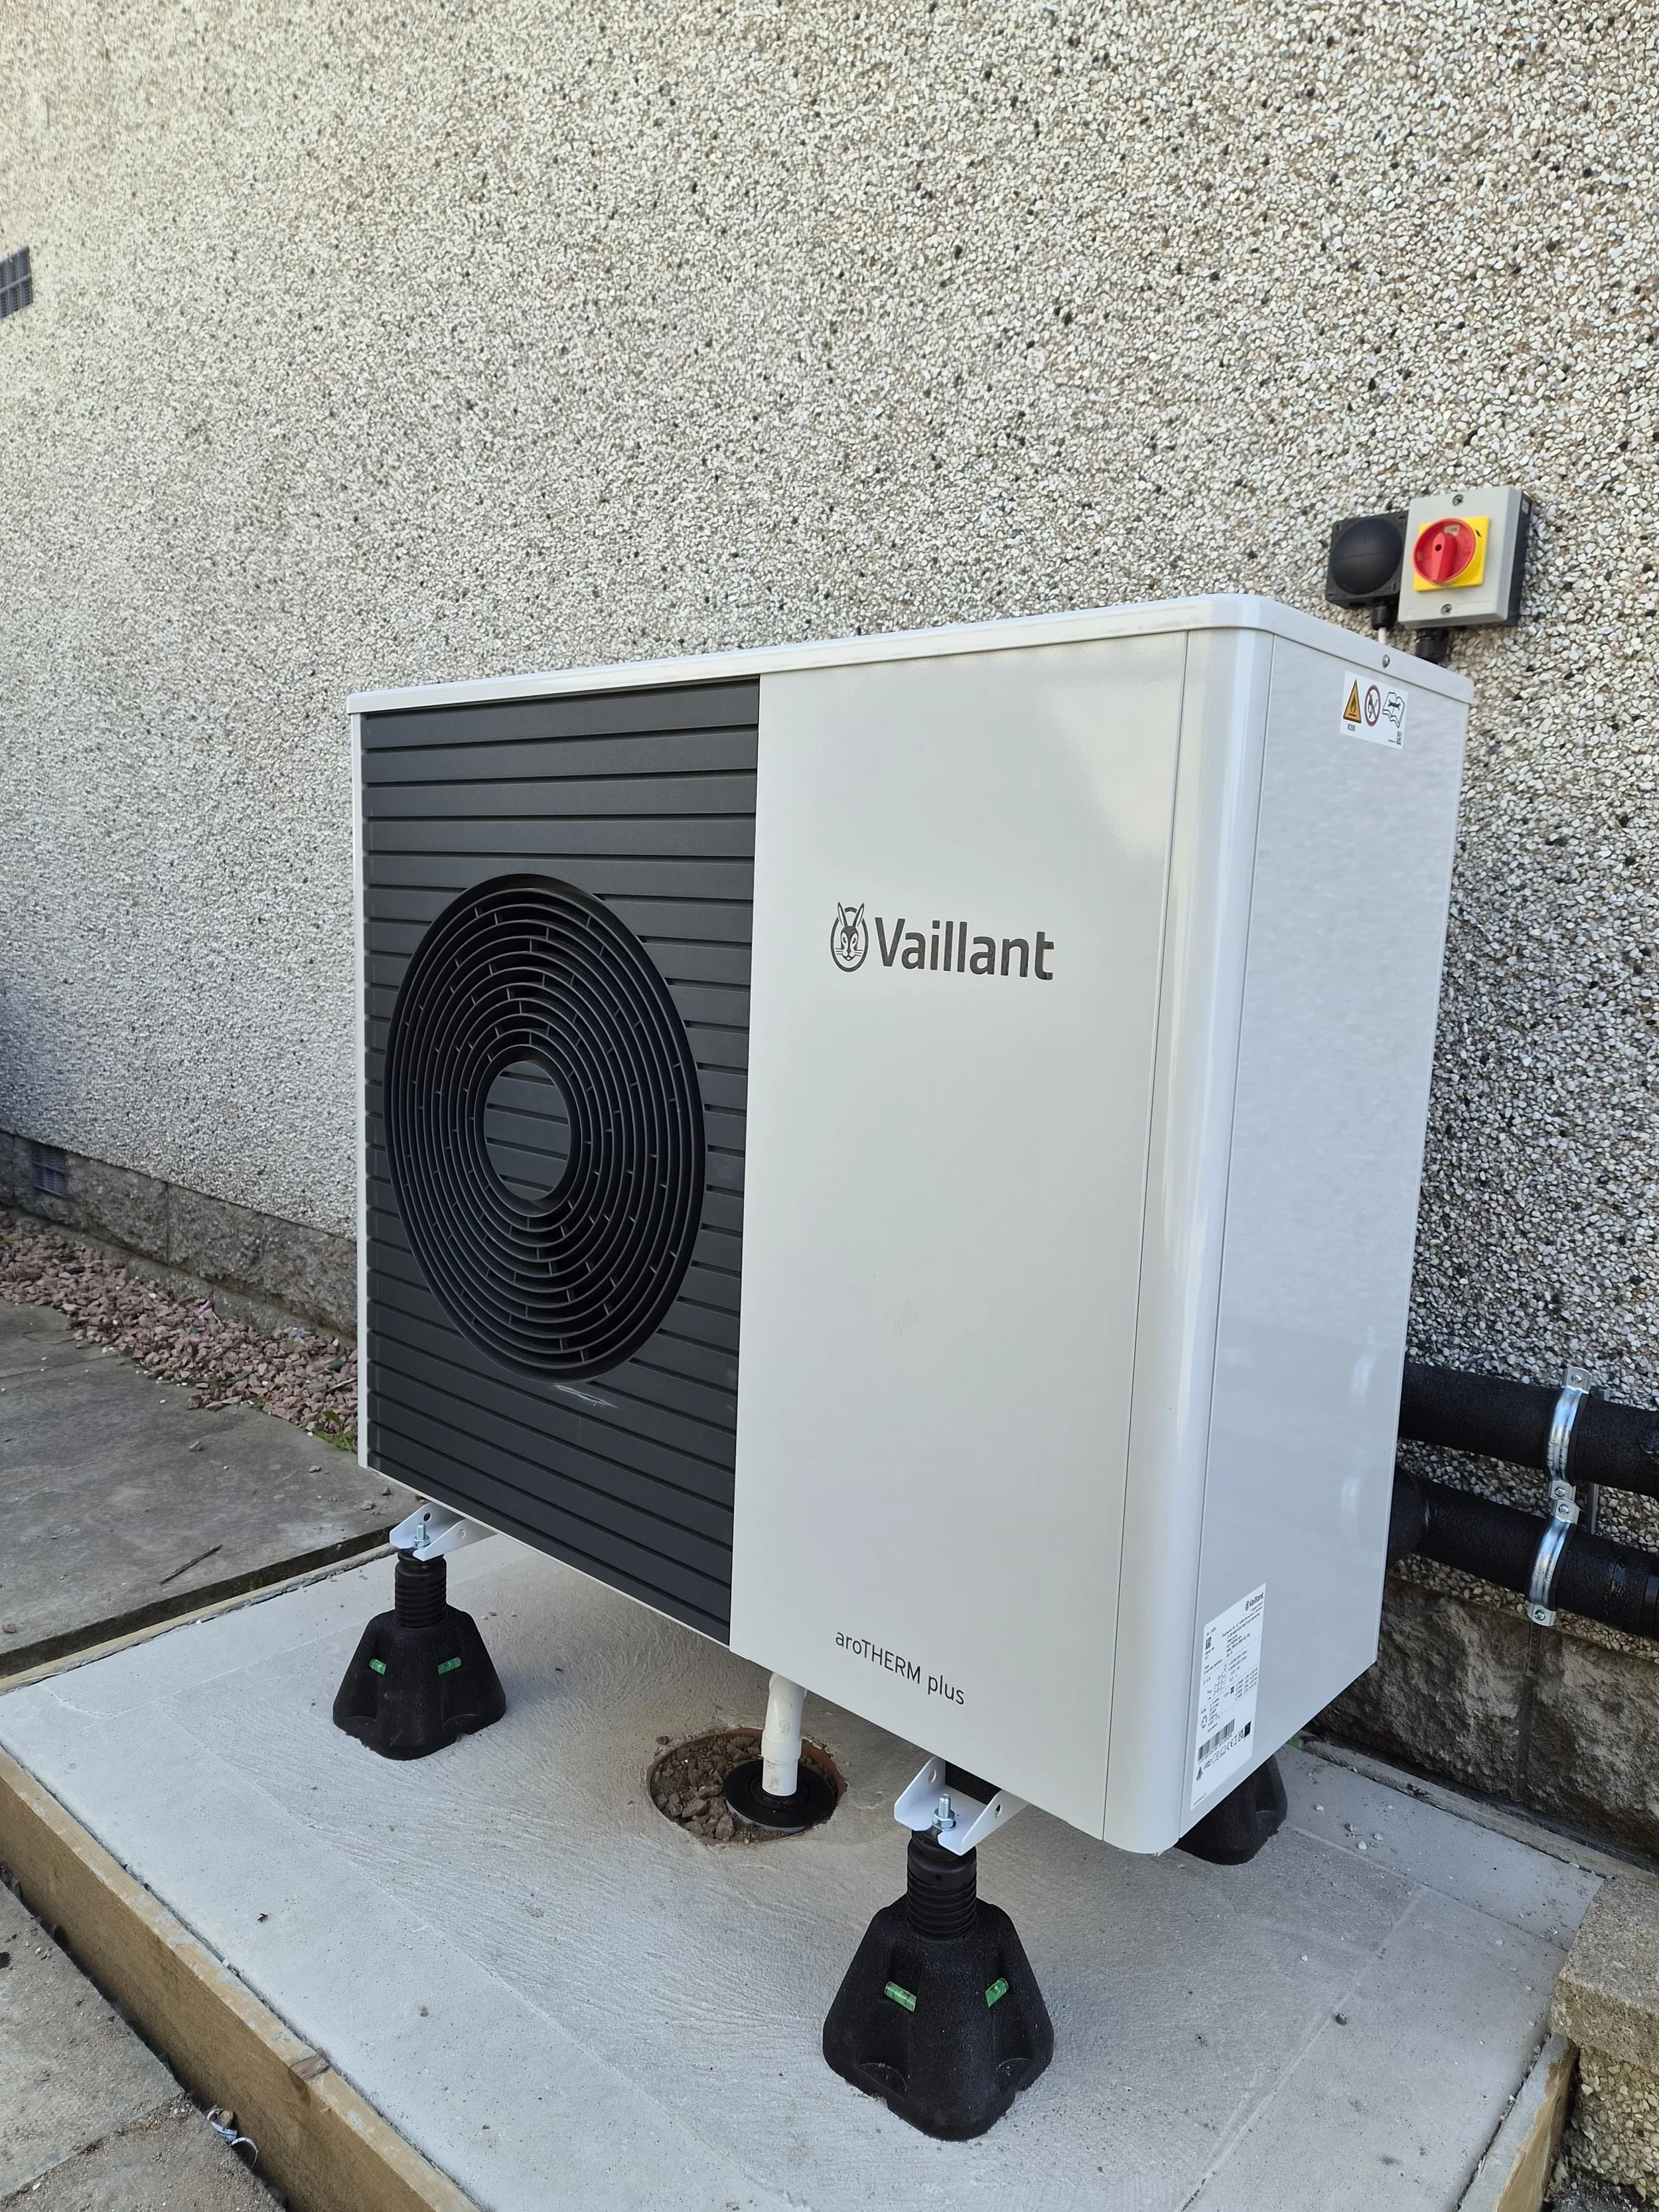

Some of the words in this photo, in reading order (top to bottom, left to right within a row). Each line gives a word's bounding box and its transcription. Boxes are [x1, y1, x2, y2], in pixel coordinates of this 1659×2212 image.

[874, 917, 1055, 980] Vaillant
[835, 1631, 921, 1684] aroTHERM
[928, 1674, 965, 1706] plus
